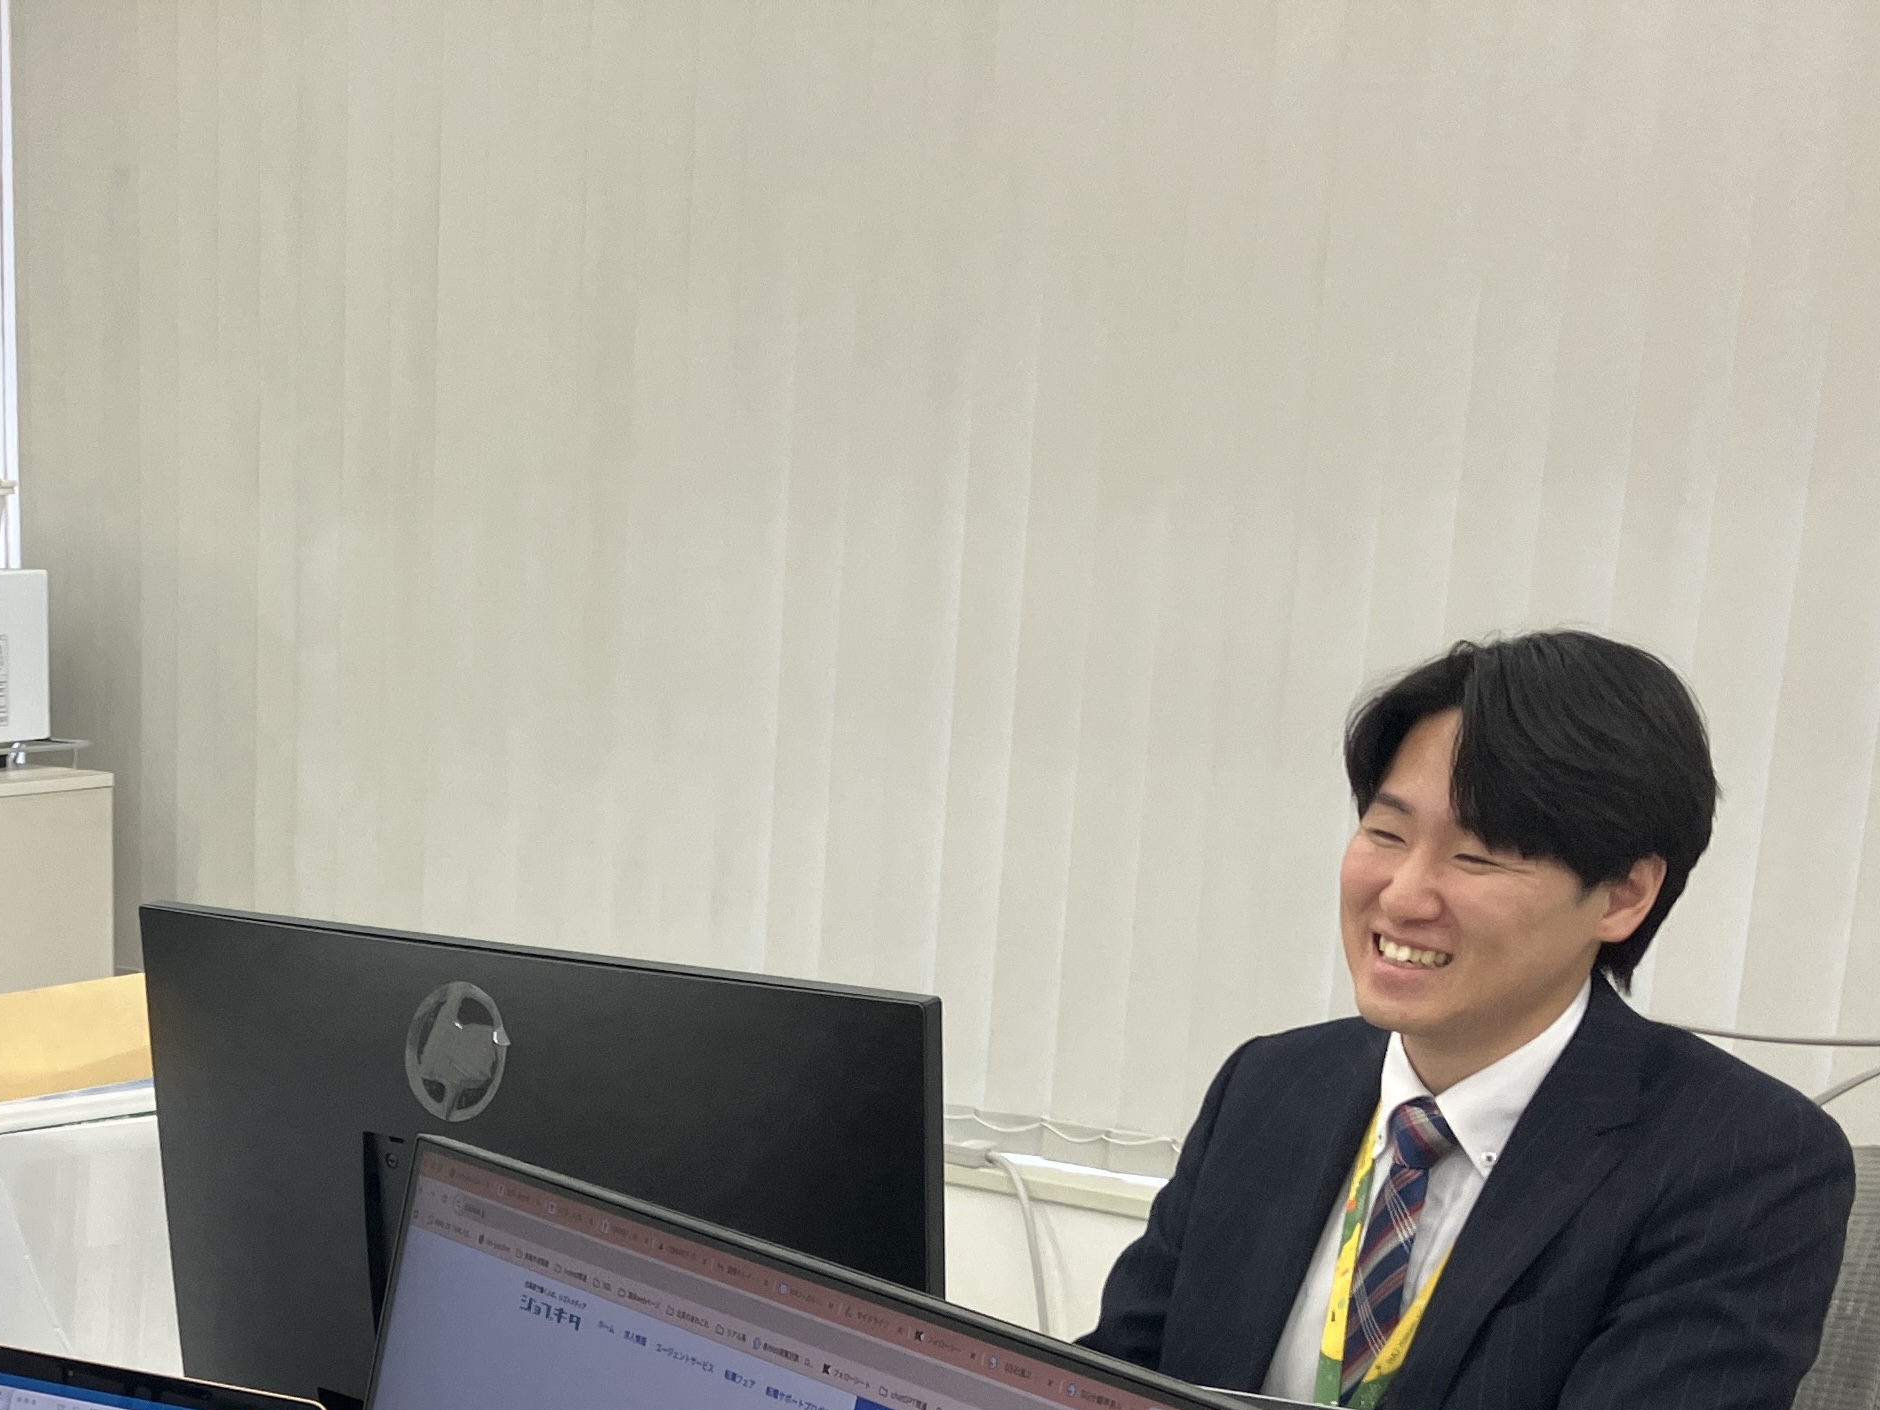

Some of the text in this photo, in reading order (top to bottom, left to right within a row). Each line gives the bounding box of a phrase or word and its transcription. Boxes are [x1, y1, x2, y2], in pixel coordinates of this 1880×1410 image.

[655, 1343, 714, 1373] エージェントサービス
